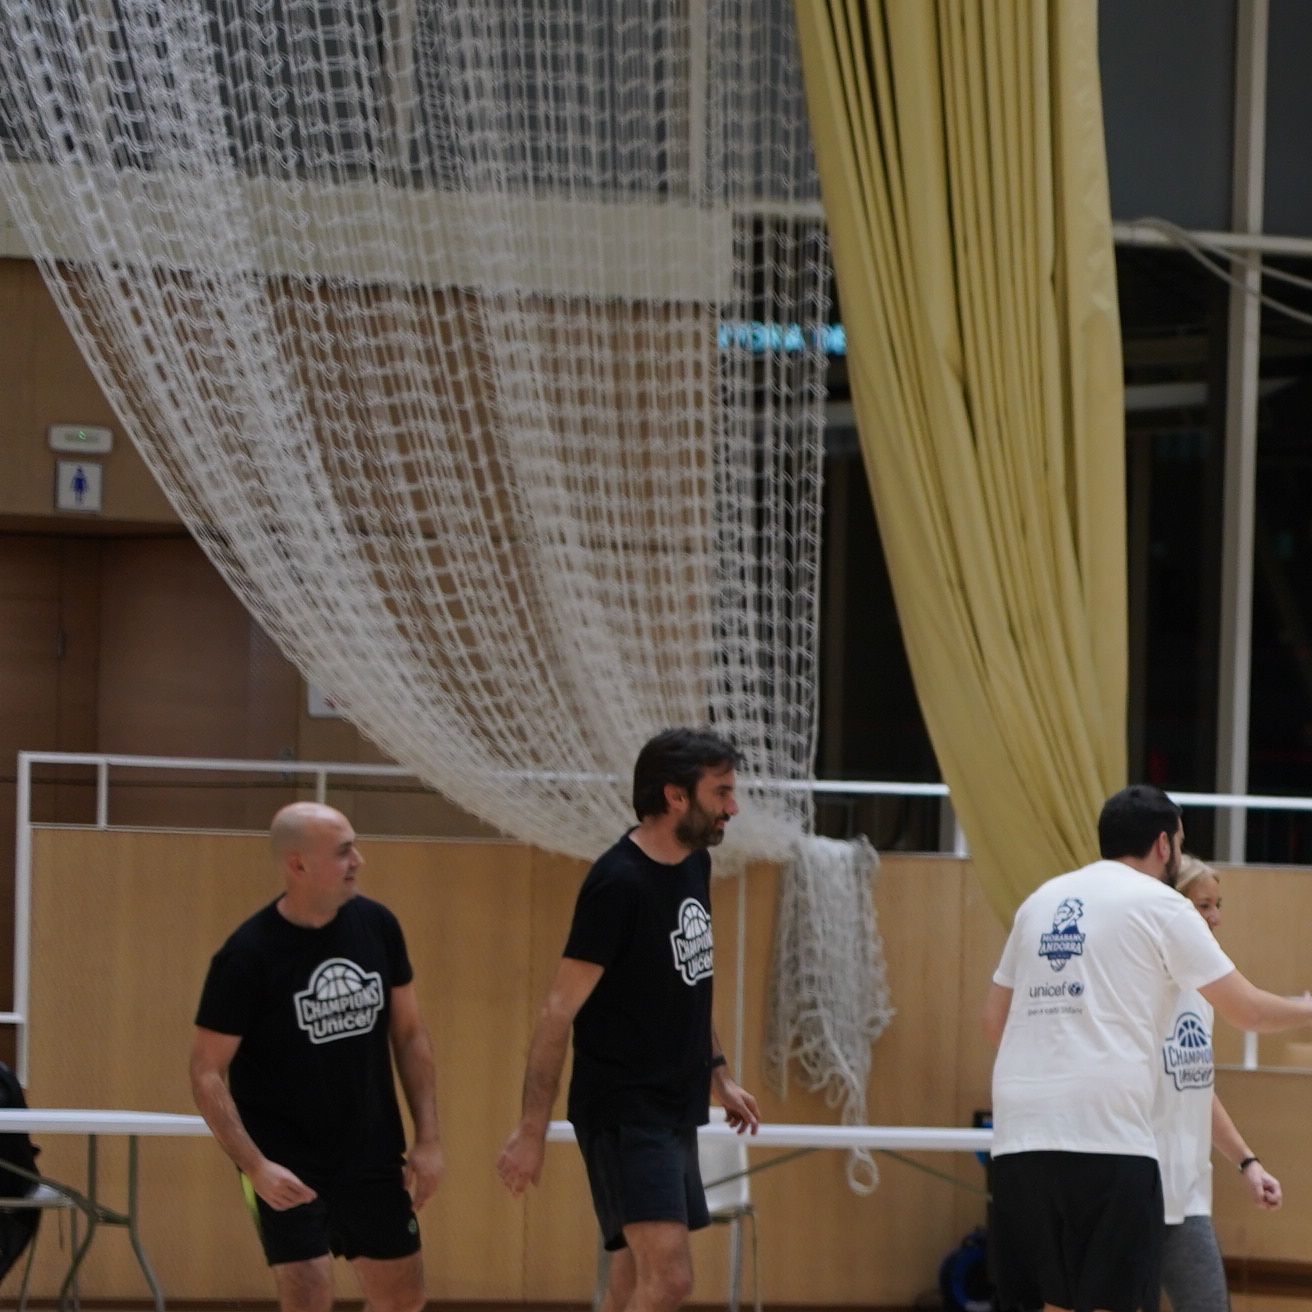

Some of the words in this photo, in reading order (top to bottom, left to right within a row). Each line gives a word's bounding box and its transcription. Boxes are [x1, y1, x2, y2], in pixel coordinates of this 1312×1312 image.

[1041, 941, 1082, 953] ANDORRA
[1030, 982, 1067, 998] unicef
[302, 980, 380, 1022] CHAMPIONS
